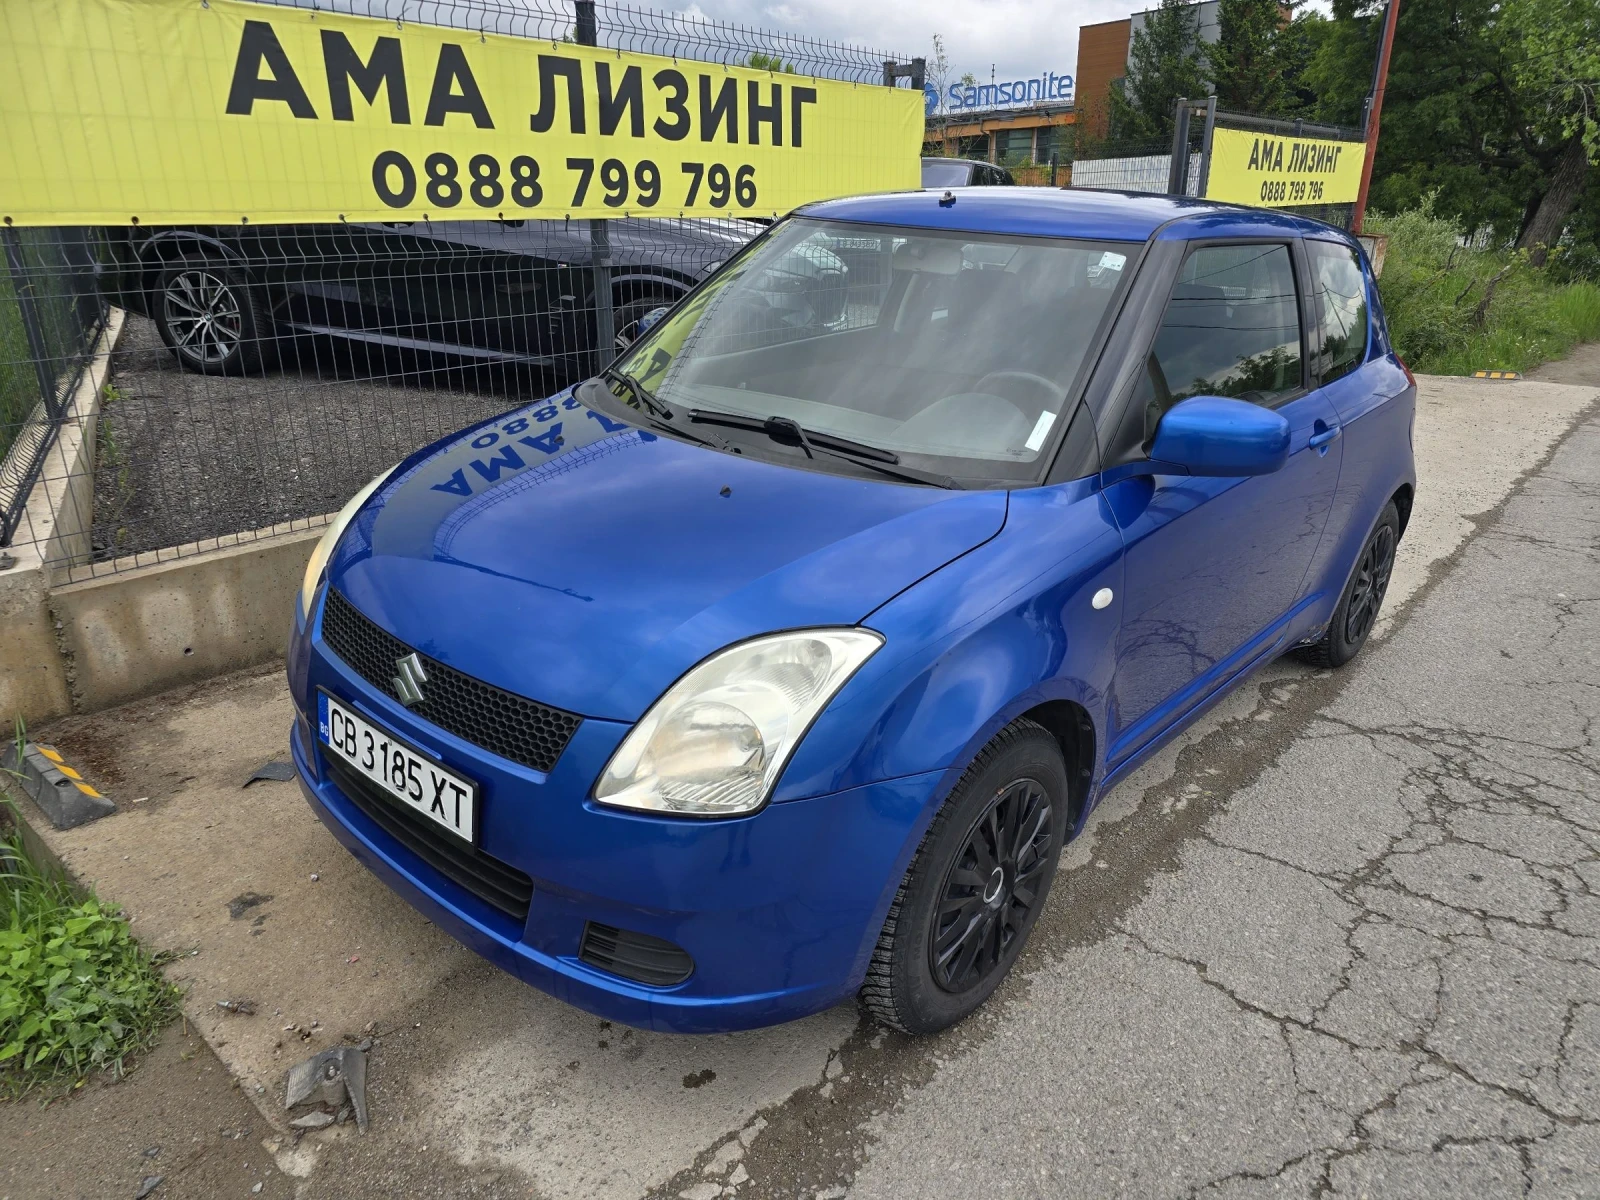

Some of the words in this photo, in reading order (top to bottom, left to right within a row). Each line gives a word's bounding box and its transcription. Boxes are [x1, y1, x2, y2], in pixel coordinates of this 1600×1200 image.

[226, 19, 495, 129] АМА
[530, 54, 817, 148] ЛИЗИНГ
[949, 71, 1073, 110] Samsonite
[1247, 138, 1283, 172] АМА
[1287, 143, 1342, 173] ЛИЗИНГ
[371, 150, 543, 209] 0888
[566, 157, 662, 208] 799
[681, 161, 757, 208] 796
[1260, 180, 1286, 202] 0888
[1288, 181, 1306, 201] 799
[1307, 181, 1324, 200] 796
[320, 721, 329, 737] BG
[331, 708, 357, 759] CB
[361, 730, 424, 802] 3185
[430, 770, 468, 829] XT
